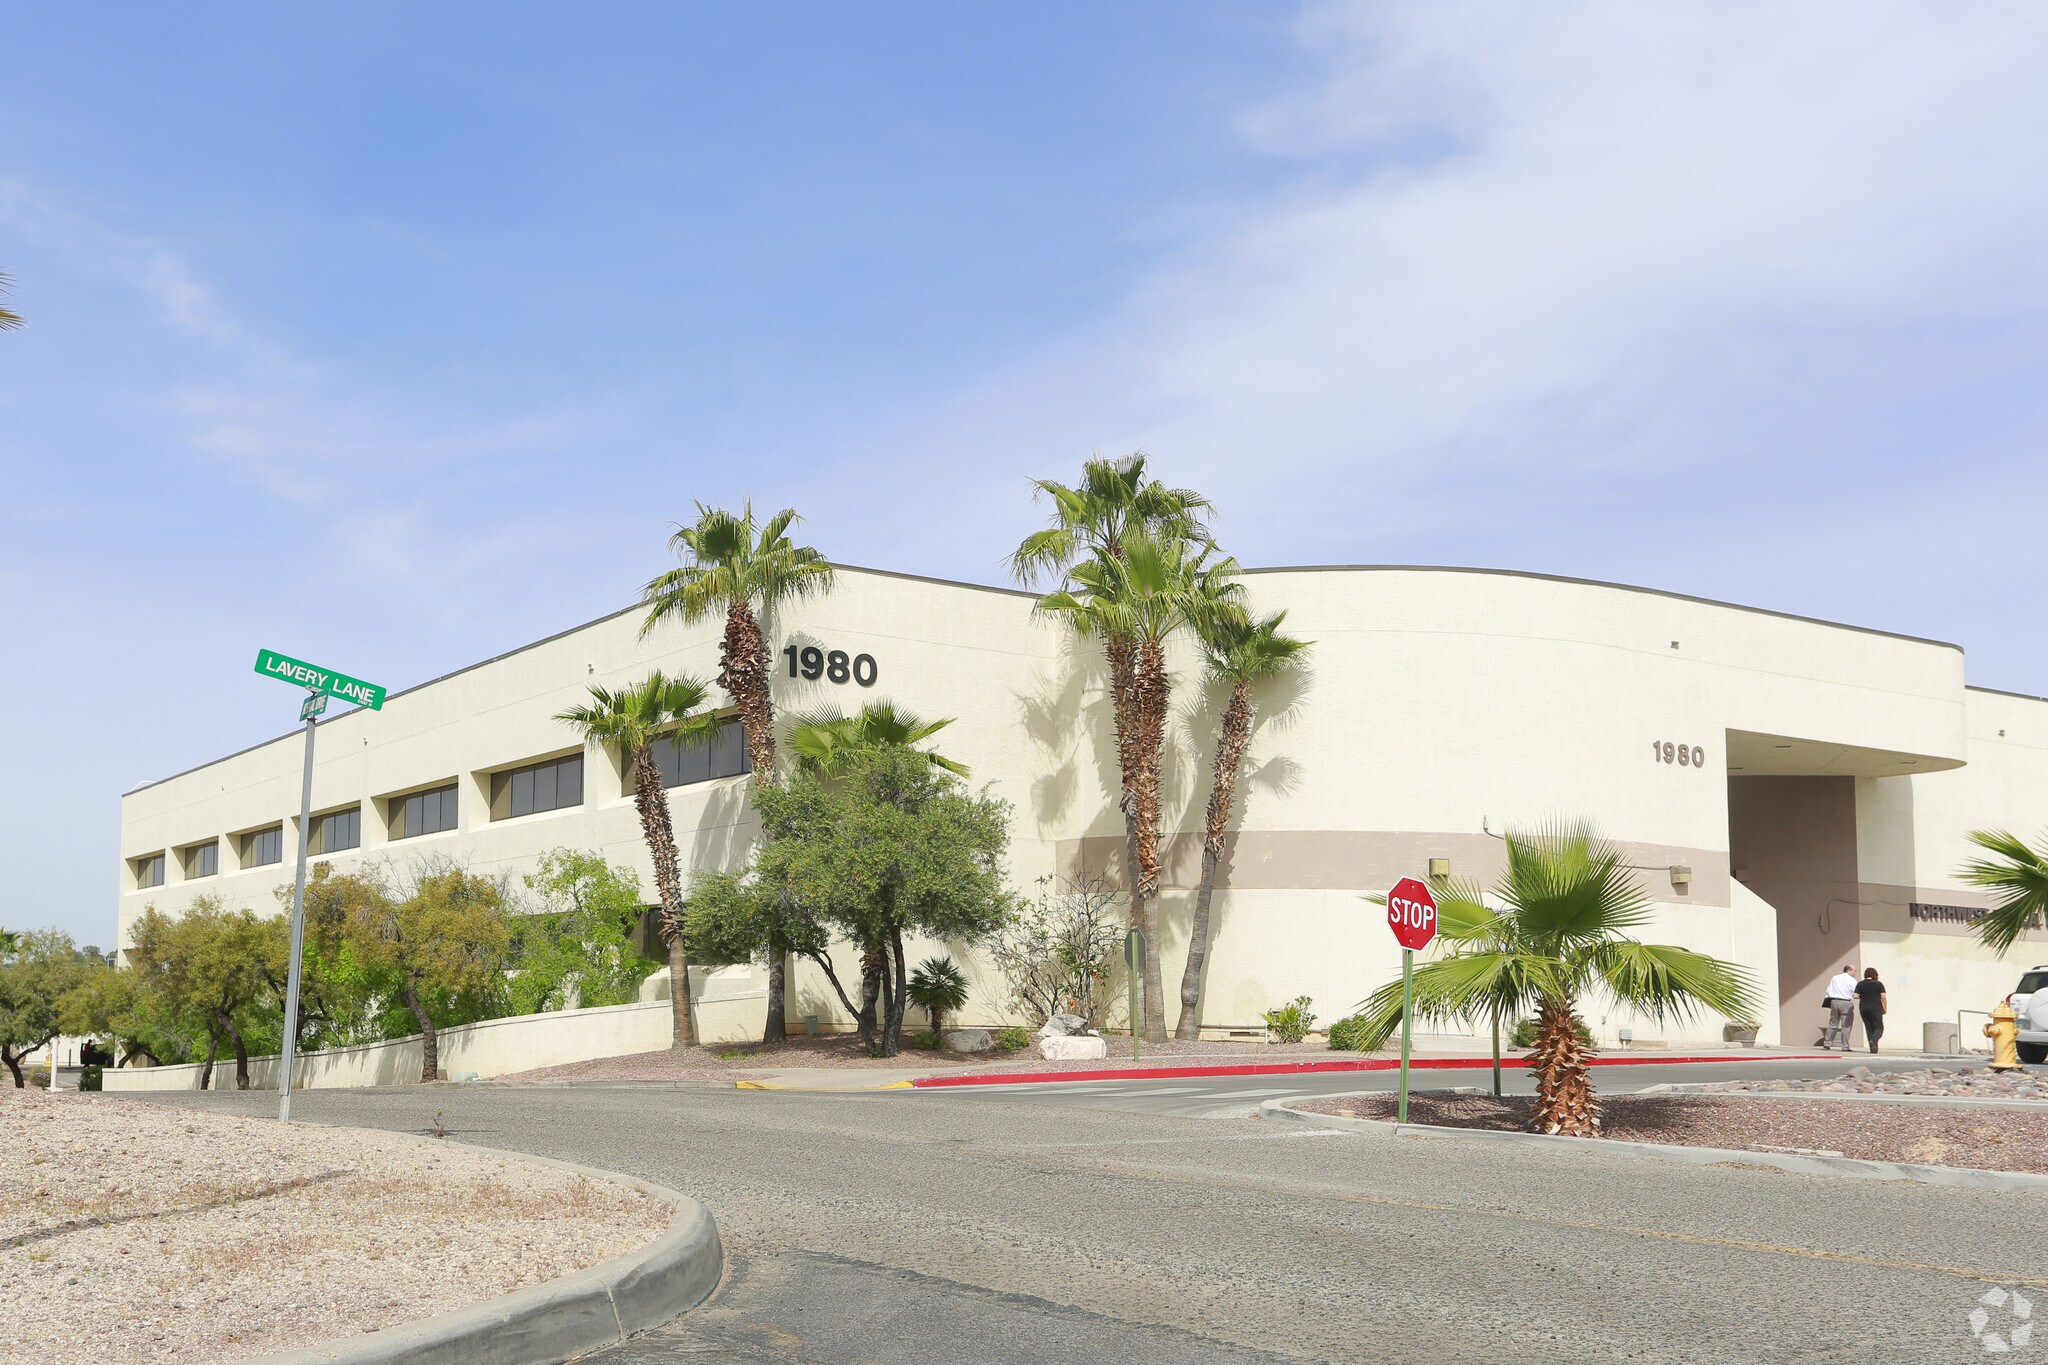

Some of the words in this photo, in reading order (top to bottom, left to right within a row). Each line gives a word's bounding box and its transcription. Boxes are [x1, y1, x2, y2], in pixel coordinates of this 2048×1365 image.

[265, 656, 328, 687] LAVERY
[332, 678, 376, 703] LANE
[784, 645, 878, 687] 1980
[1652, 740, 1705, 769] 1980
[1390, 896, 1434, 931] STOP
